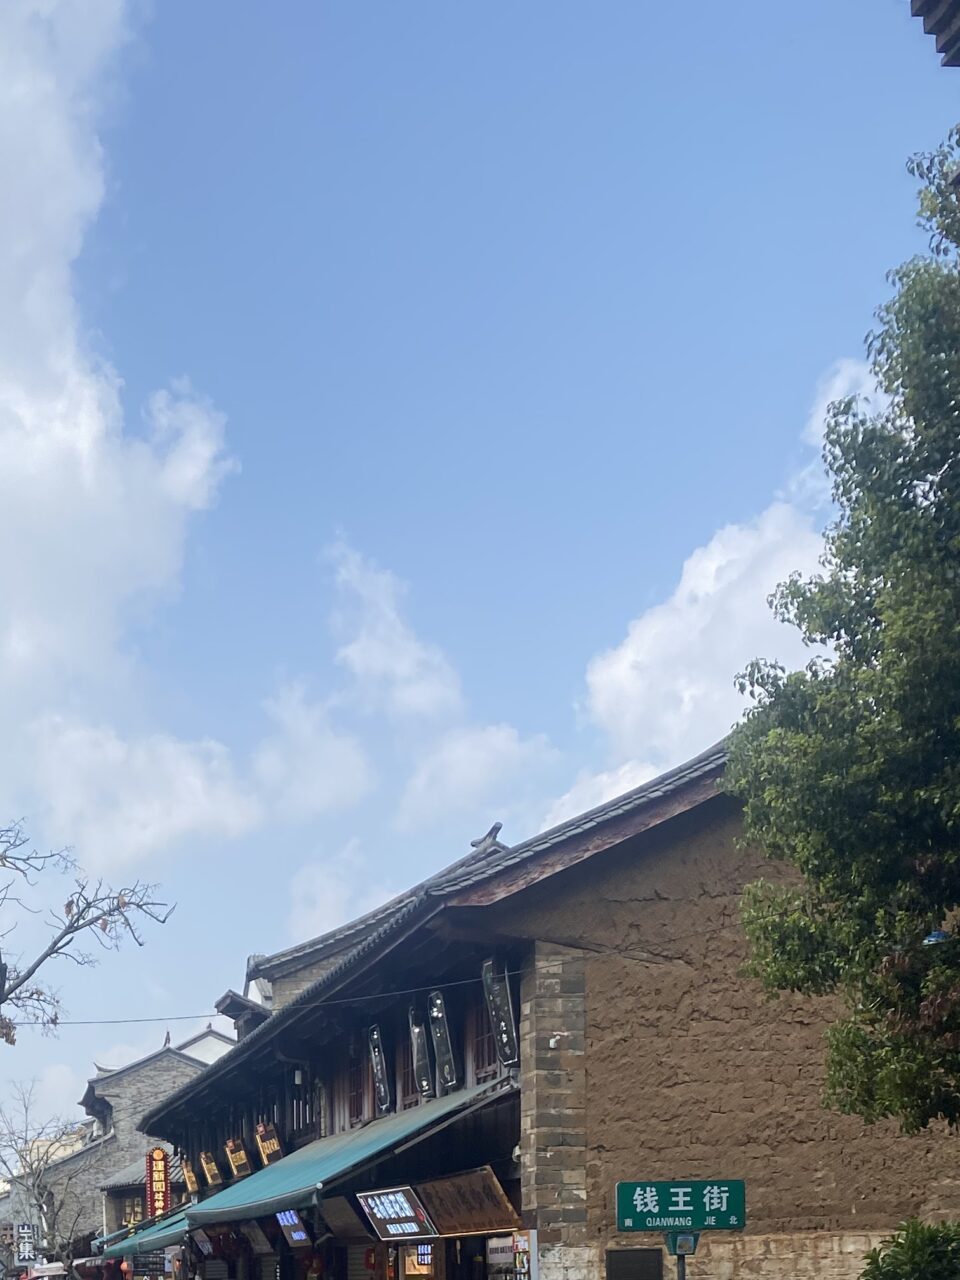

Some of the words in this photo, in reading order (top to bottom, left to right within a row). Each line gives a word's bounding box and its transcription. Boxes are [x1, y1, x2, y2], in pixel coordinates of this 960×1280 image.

[633, 1185, 730, 1213] 钱王街
[624, 1218, 633, 1227] 南
[646, 1216, 692, 1226] QIANWANG
[704, 1216, 716, 1225] JIE
[729, 1215, 738, 1225] 北
